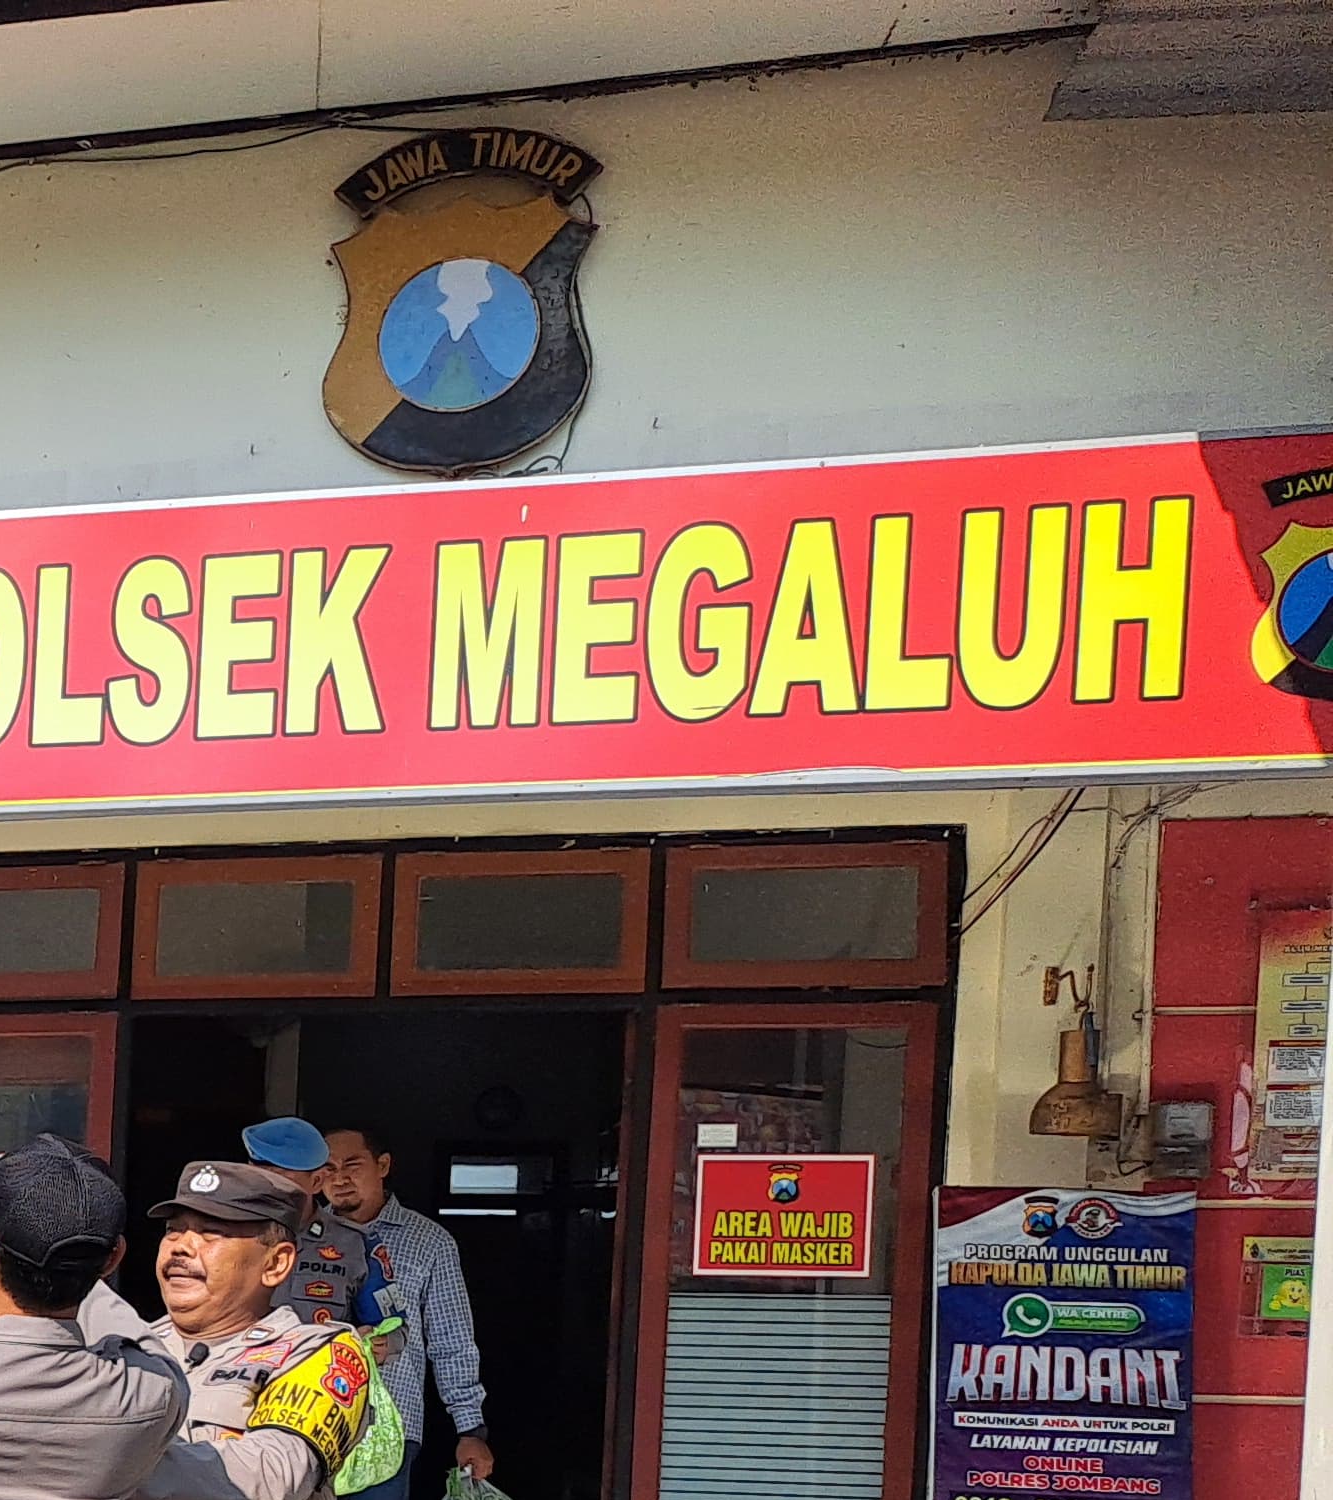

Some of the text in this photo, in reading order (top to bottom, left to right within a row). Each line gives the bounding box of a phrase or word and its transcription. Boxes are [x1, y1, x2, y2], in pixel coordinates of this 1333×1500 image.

[365, 132, 583, 200] JAWA TIMUR
[1282, 473, 1333, 499] JAW
[427, 495, 1193, 731] MEGALUH
[713, 1211, 854, 1238] AREA WAJIB
[710, 1242, 853, 1265] PAKAI MASKER
[964, 1243, 1168, 1263] PROGRAM UNGGULAN
[299, 1261, 346, 1277] POLRI
[1050, 1263, 1112, 1288] JAWA
[1113, 1265, 1187, 1290] TIMUR
[1057, 1307, 1078, 1317] WA
[210, 1368, 270, 1388] POLR
[259, 1381, 324, 1414] KANIT
[252, 1407, 308, 1430] POLSEK
[958, 1415, 1170, 1432] KOMUNIKASI ANDA UNTUK POLRI
[970, 1434, 1159, 1455] LAYANAN KEPOLISIAN
[1023, 1456, 1103, 1473] ONLINE
[967, 1471, 1161, 1494] POLRES JOMBANG
